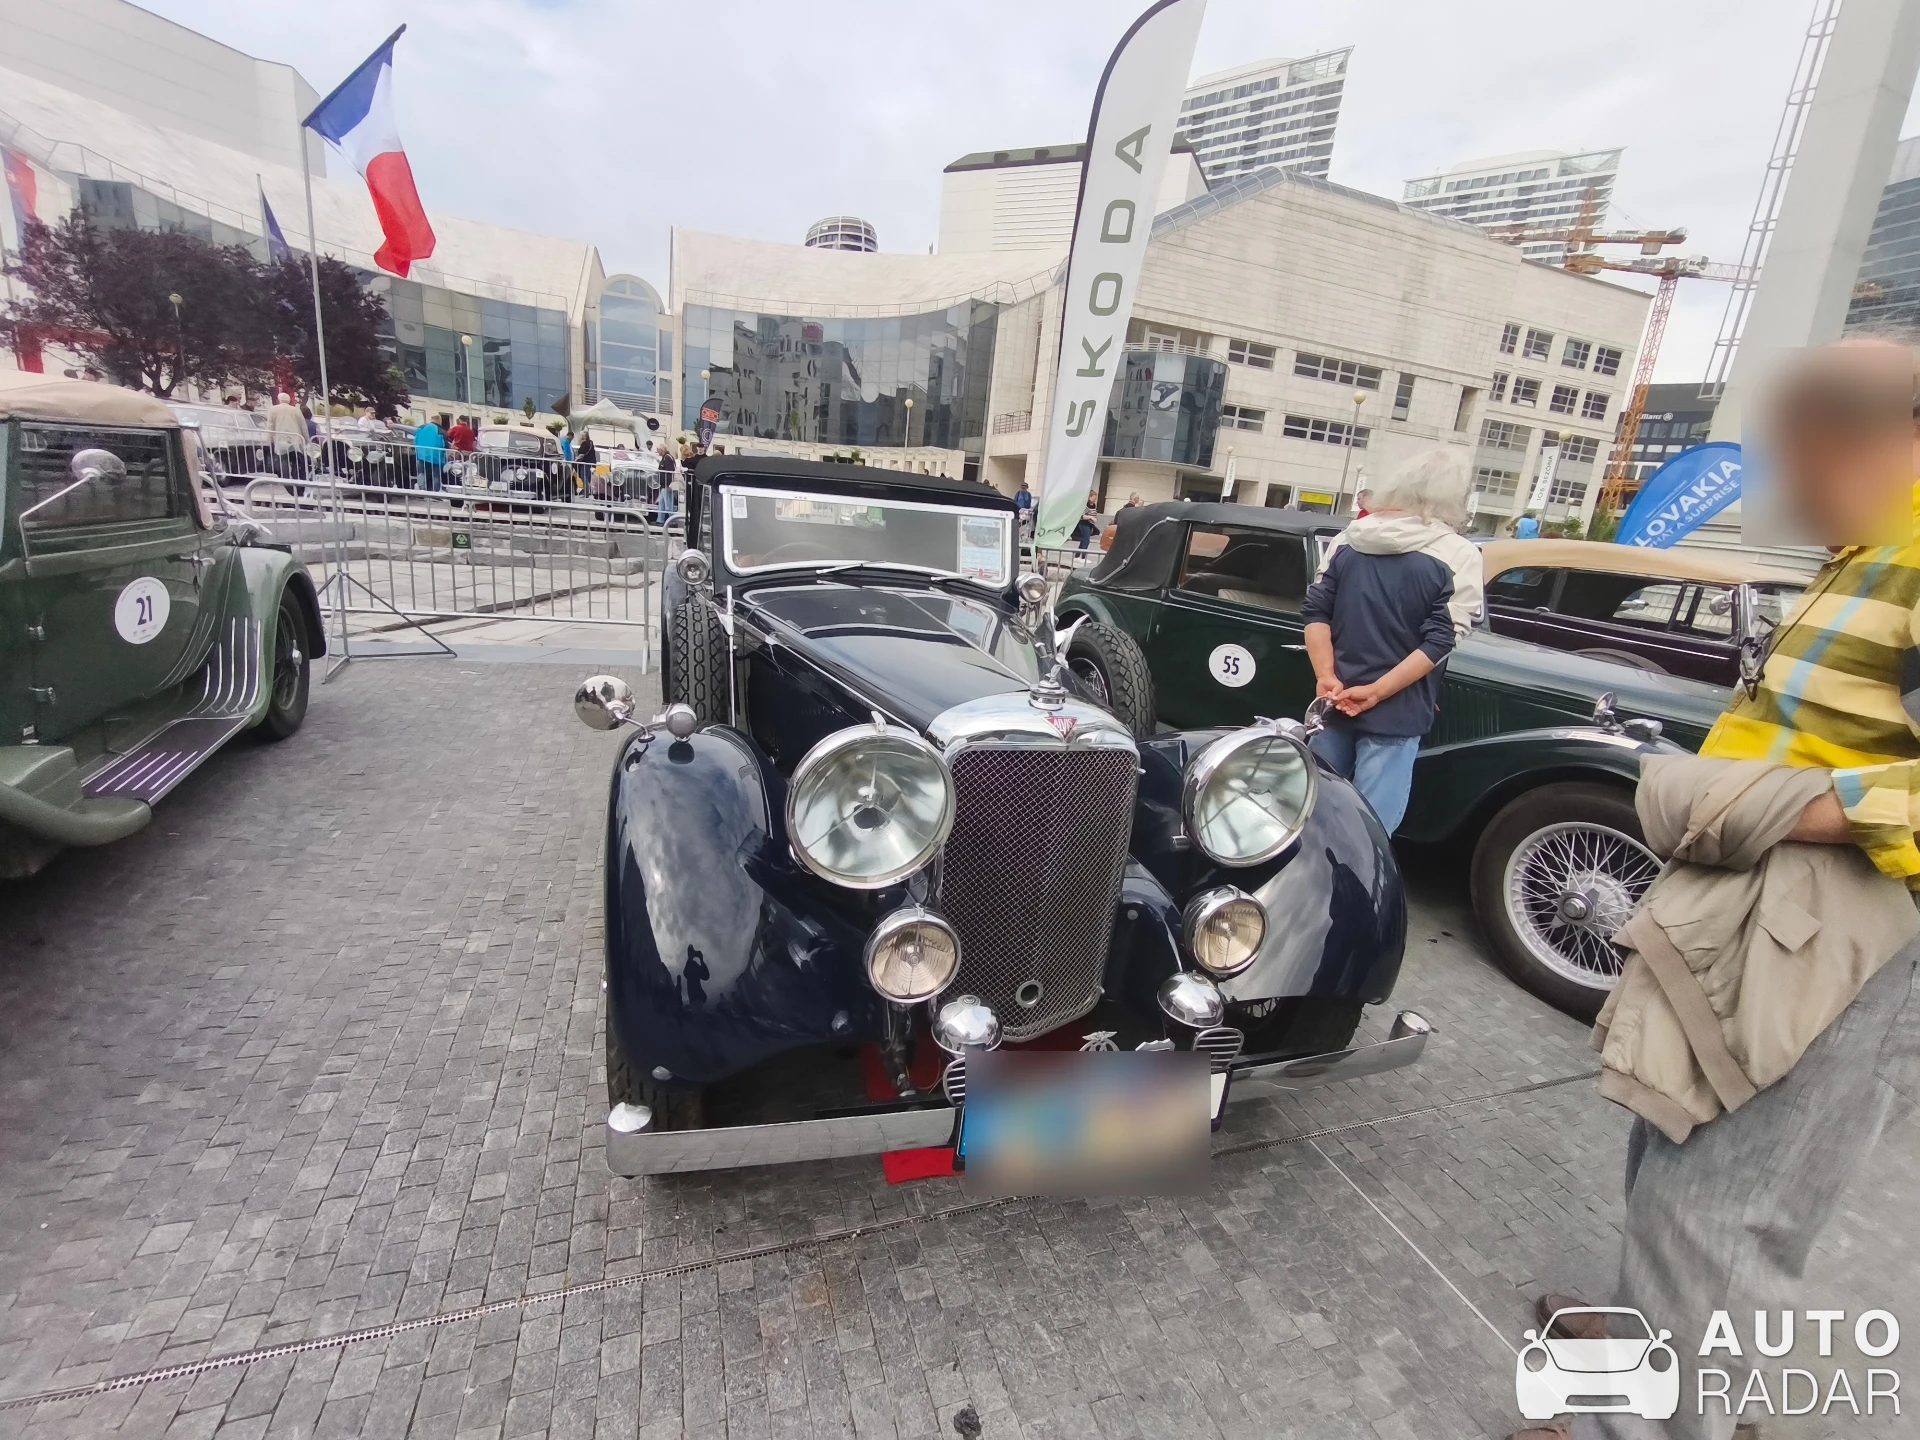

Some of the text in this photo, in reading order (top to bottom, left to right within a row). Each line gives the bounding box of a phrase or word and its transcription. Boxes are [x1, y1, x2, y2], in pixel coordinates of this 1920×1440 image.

[1633, 460, 1741, 547] LOVAKIA
[1685, 479, 1740, 524] SURPRISE
[136, 595, 152, 626] 21
[1222, 655, 1240, 676] 55
[1053, 718, 1073, 736] ALVIS
